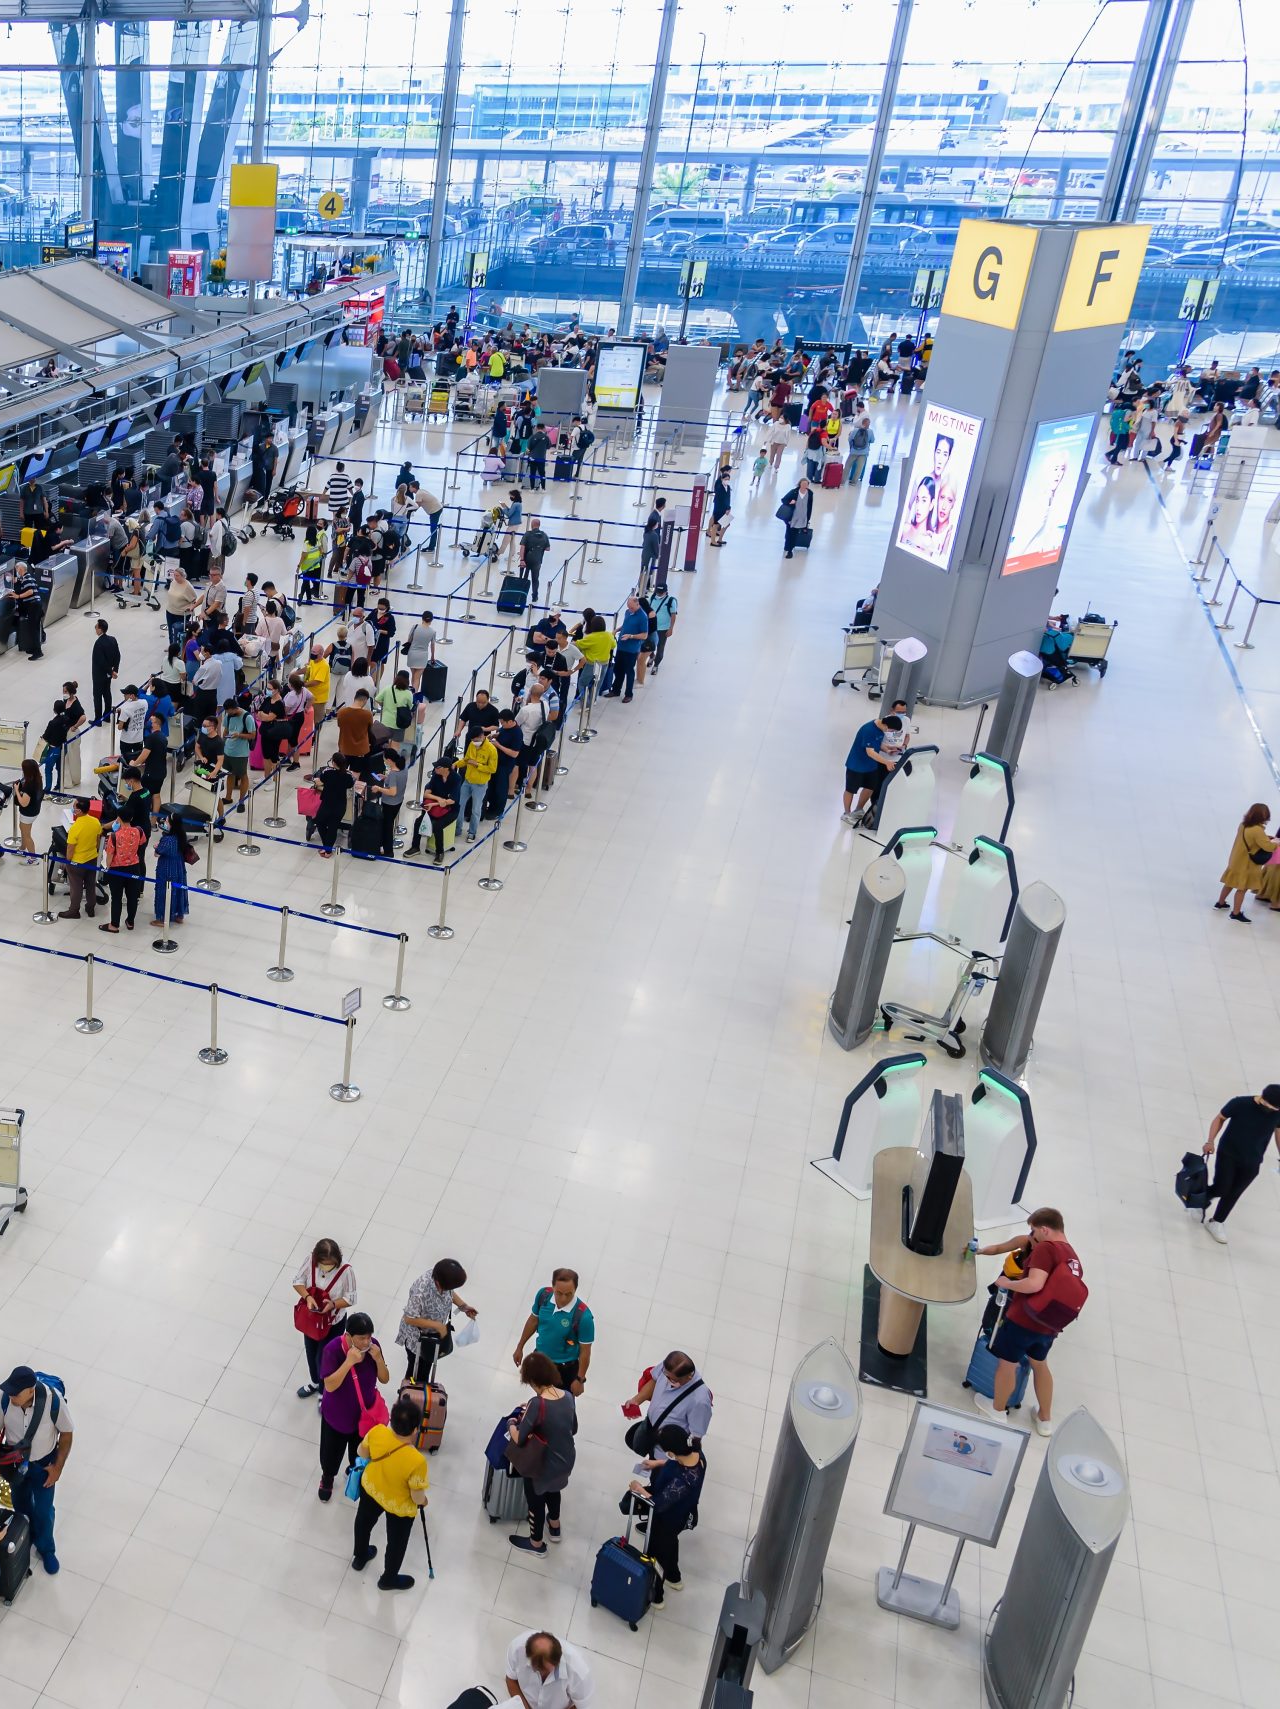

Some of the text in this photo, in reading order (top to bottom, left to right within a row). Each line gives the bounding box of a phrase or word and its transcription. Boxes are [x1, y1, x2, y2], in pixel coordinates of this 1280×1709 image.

[324, 195, 336, 217] 4
[972, 246, 1120, 306] G F
[928, 410, 976, 436] MISTINE
